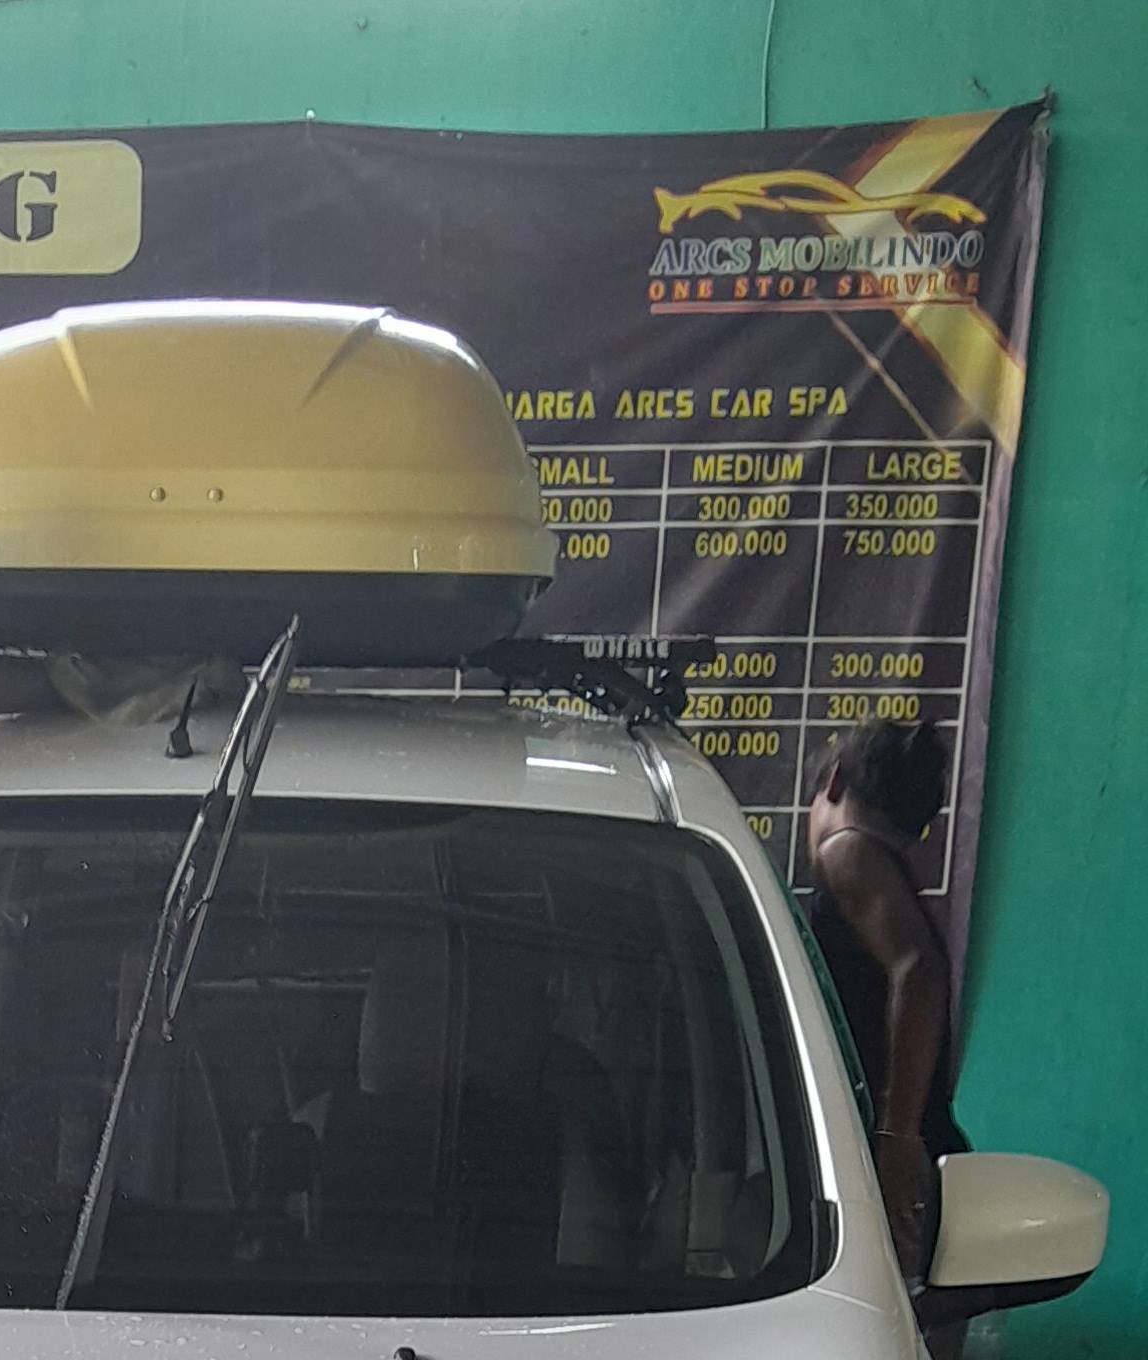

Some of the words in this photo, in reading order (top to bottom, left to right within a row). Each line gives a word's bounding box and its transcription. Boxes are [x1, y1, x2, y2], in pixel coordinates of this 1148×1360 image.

[649, 237, 752, 276] ARCS
[757, 230, 985, 274] MOBILINDO
[648, 278, 714, 302] ONE
[734, 275, 818, 299] STOP
[837, 270, 980, 296] SERVICE
[615, 389, 694, 419] ARCS
[710, 388, 773, 418] CAR
[789, 386, 848, 416] SPA
[692, 453, 804, 483] MEDIUM
[866, 450, 962, 480] LARGE
[698, 494, 790, 521] 300.000
[845, 493, 939, 520] 350.000
[694, 531, 787, 558] 600.000
[842, 529, 936, 556] 750.000
[831, 651, 924, 678] 300.000
[681, 694, 774, 720] 250.000
[828, 694, 920, 721] 300.000
